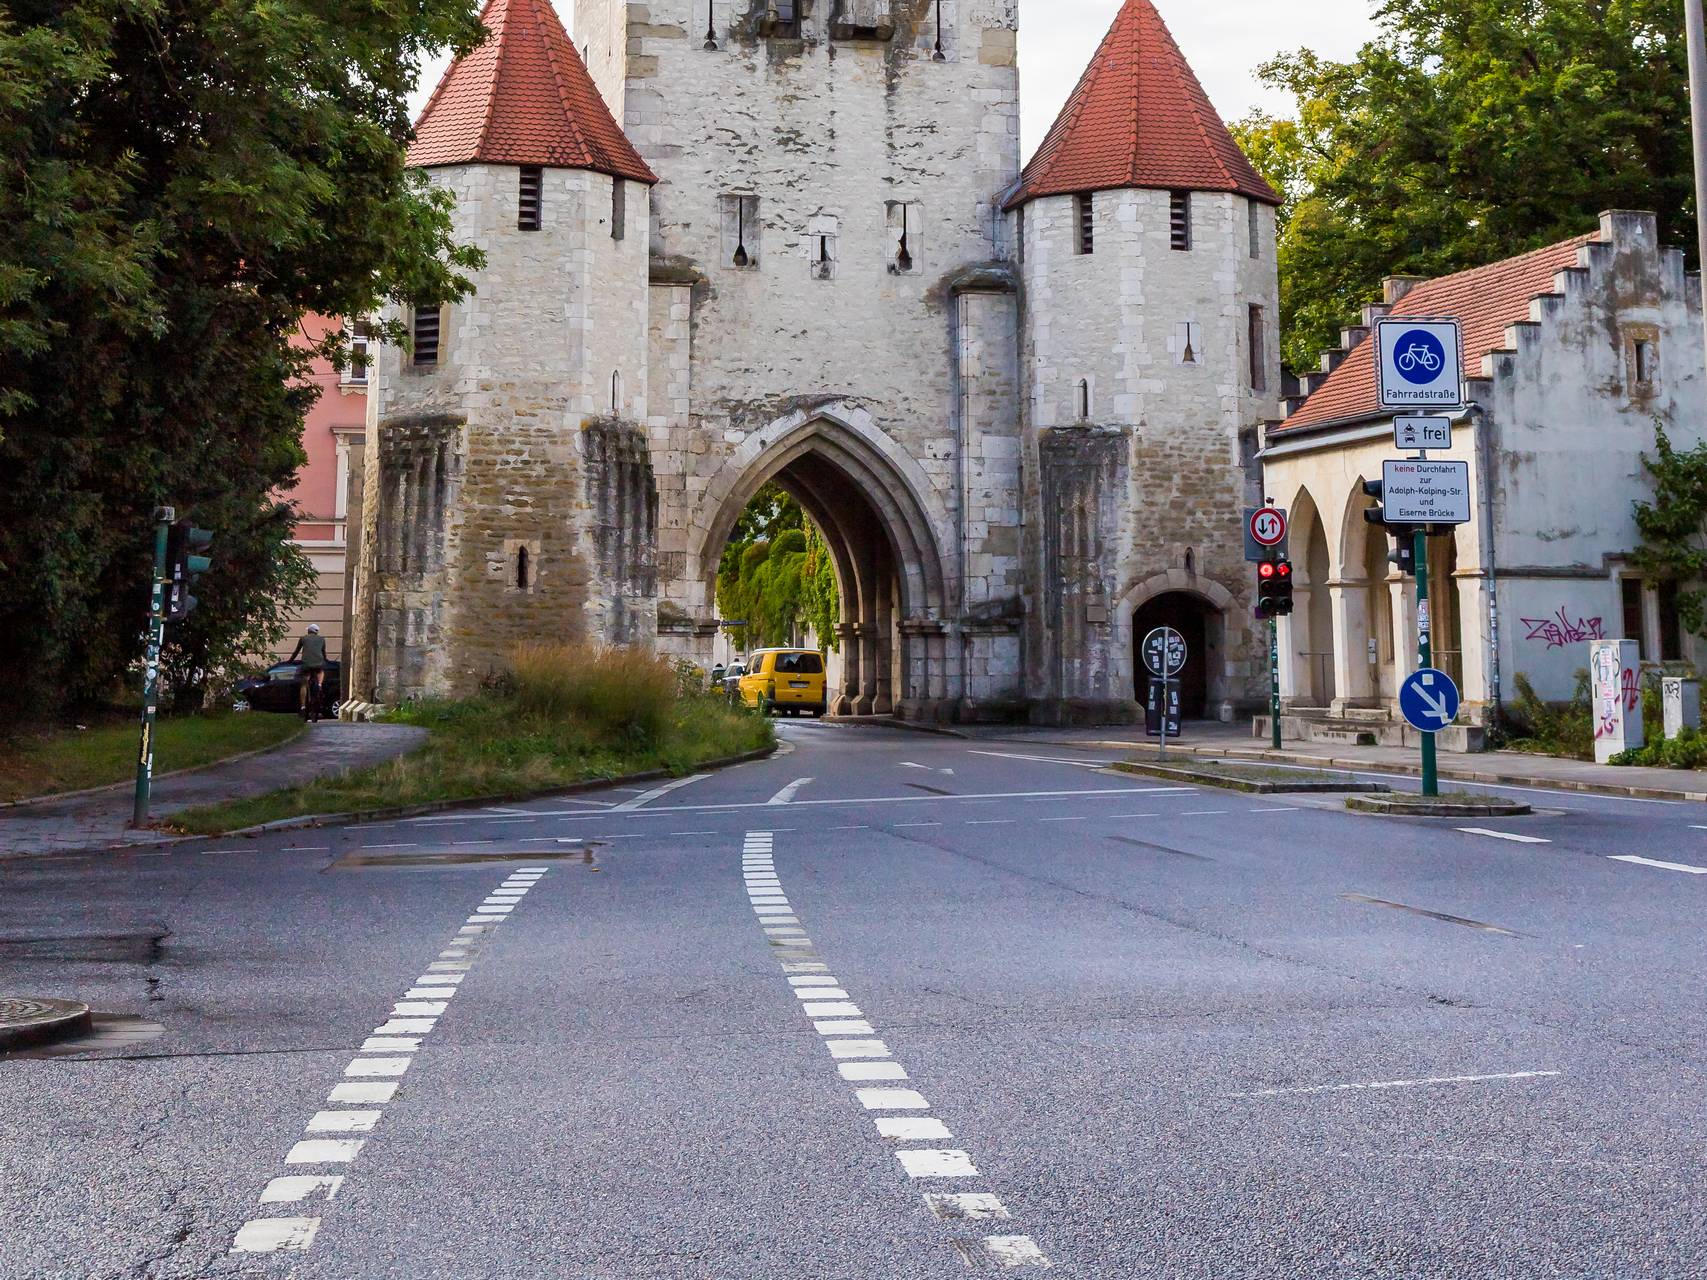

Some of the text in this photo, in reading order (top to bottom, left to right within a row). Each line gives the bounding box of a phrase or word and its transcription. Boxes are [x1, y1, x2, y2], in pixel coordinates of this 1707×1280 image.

[1386, 388, 1456, 400] Fahrradstraße
[1423, 425, 1447, 441] frei
[1394, 464, 1457, 474] keine Durchfahrt
[1388, 486, 1464, 497] Adolph-Kolping-Str.
[1419, 498, 1434, 506] und
[1399, 508, 1455, 517] Eiserne Brücke
